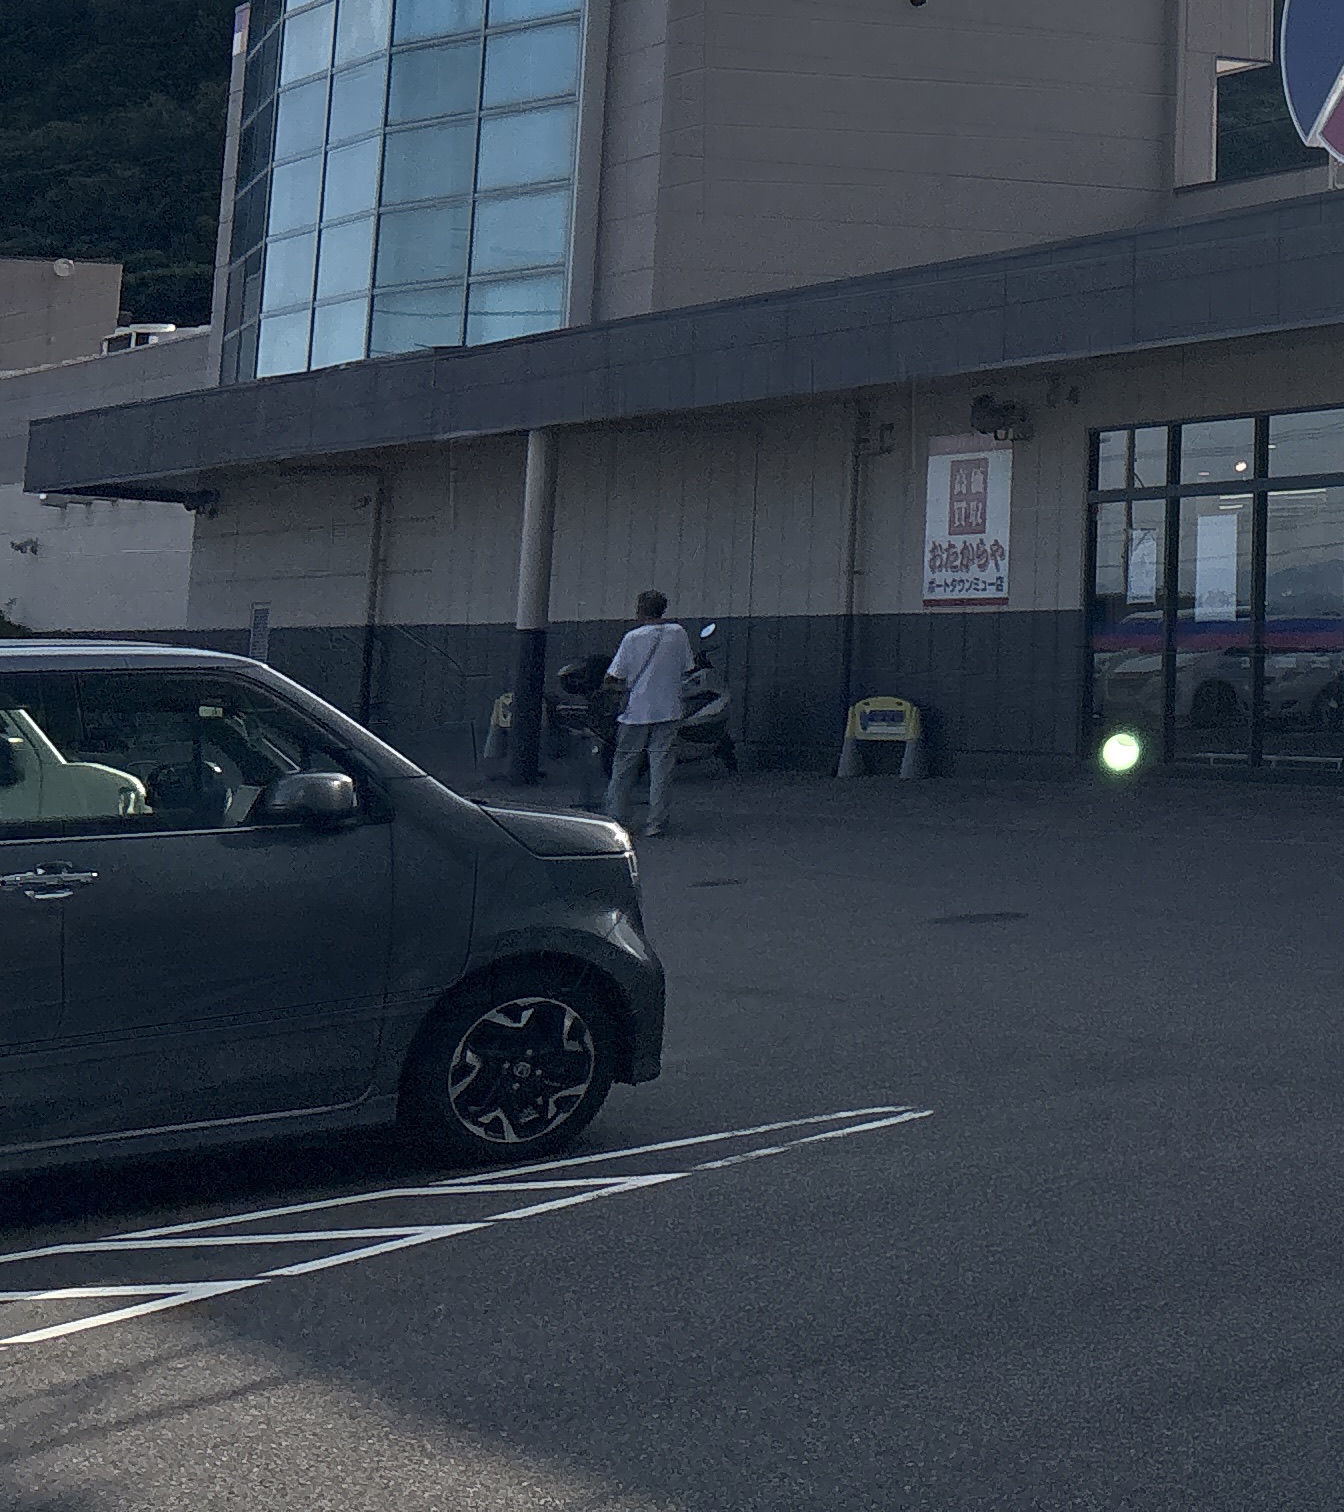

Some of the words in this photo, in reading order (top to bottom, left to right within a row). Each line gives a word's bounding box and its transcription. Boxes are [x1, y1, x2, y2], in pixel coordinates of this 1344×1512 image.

[928, 538, 1005, 574] おたからや
